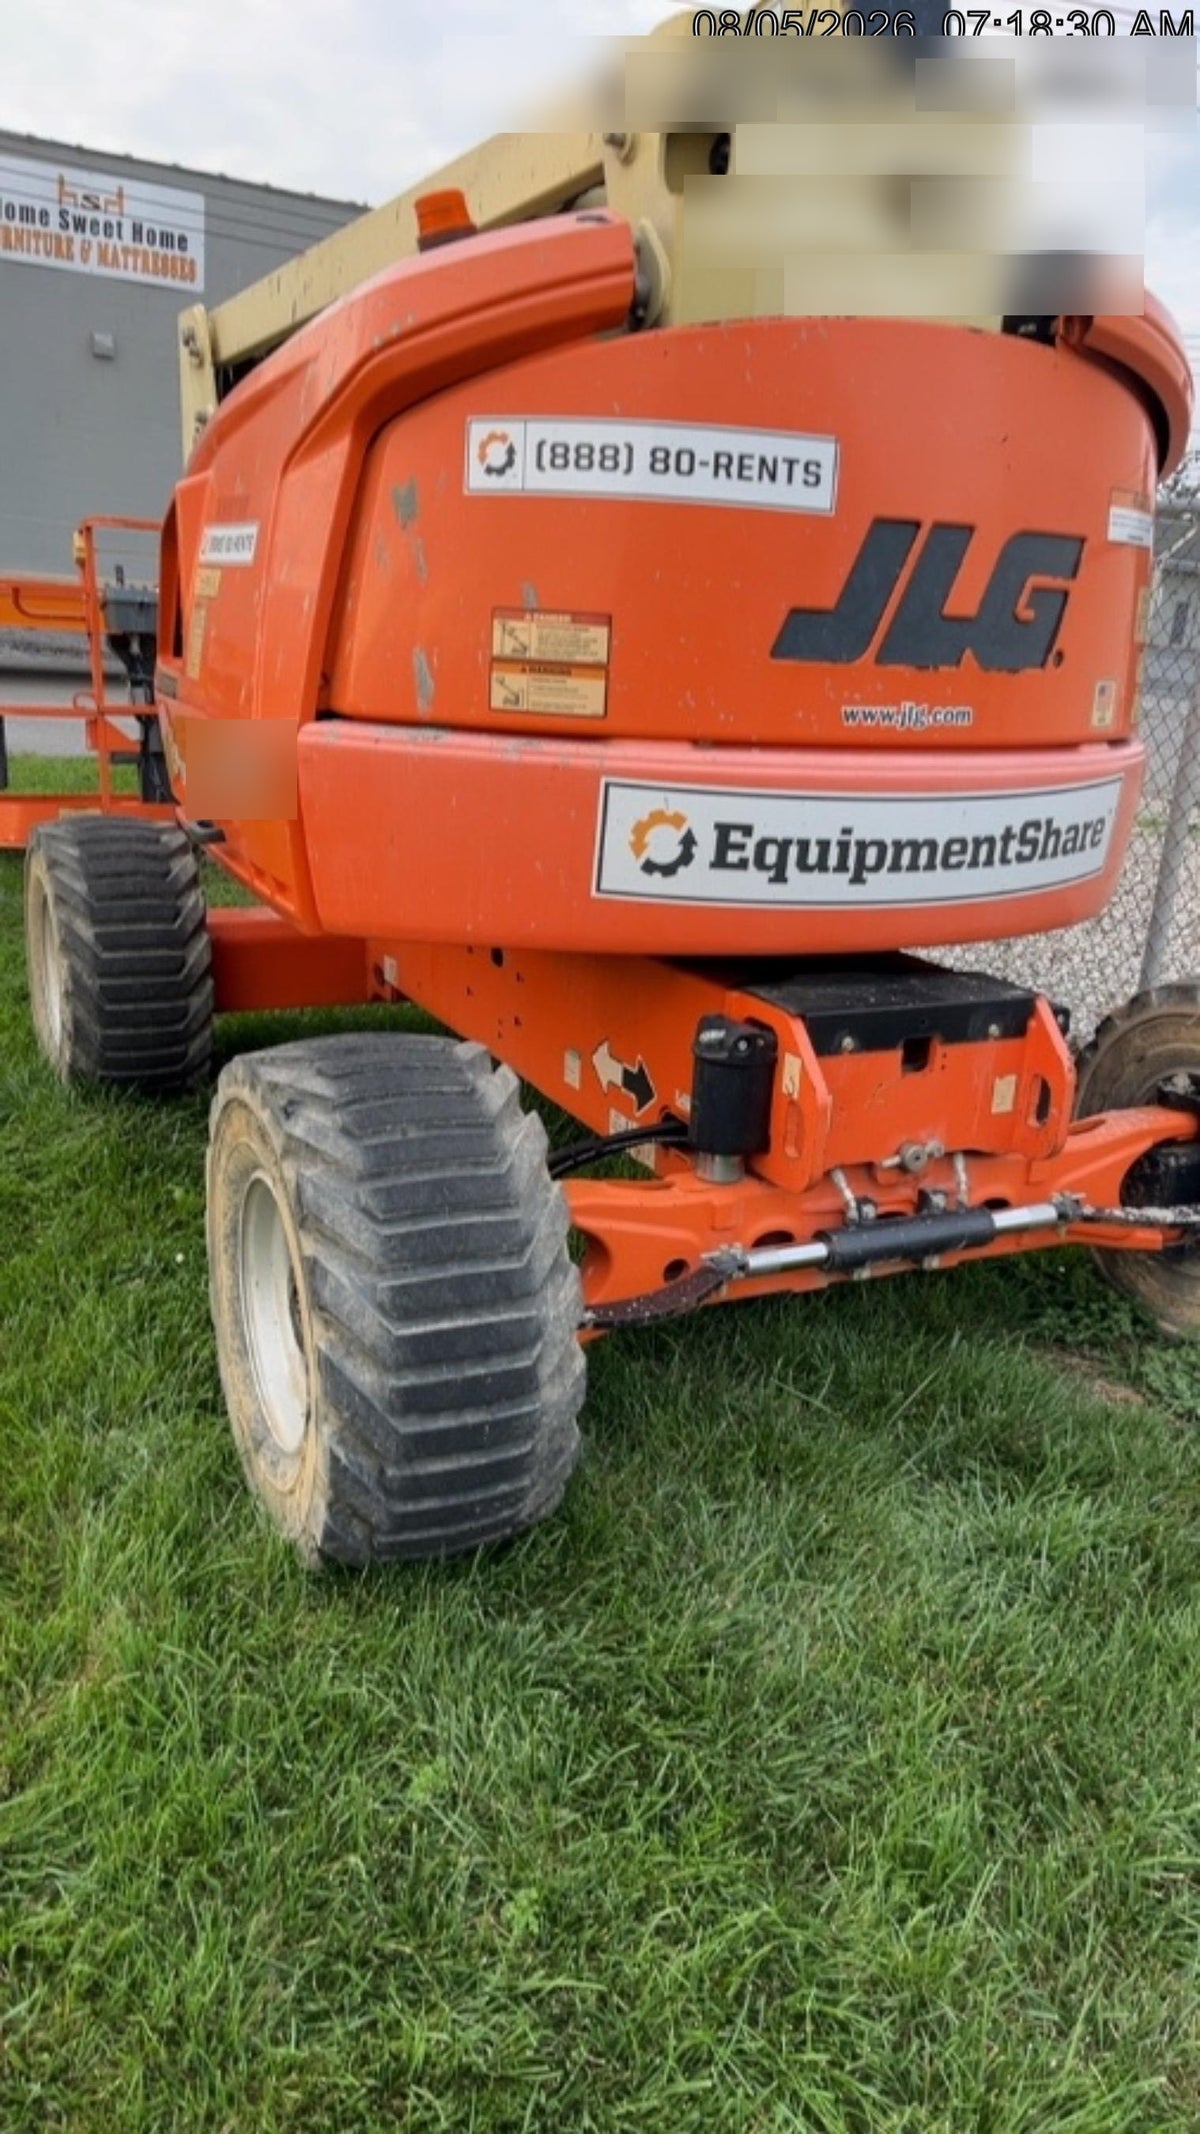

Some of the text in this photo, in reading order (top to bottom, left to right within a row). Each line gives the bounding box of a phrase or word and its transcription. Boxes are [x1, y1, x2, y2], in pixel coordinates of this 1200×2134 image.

[0, 196, 188, 253] ome Sweet Home
[0, 224, 75, 262] RNITURE
[97, 240, 197, 284] MATTRESSES
[535, 437, 823, 489] (888) 80-RENTS
[842, 701, 973, 730] www.jlg.com
[709, 815, 1106, 886] EquipmentShare
